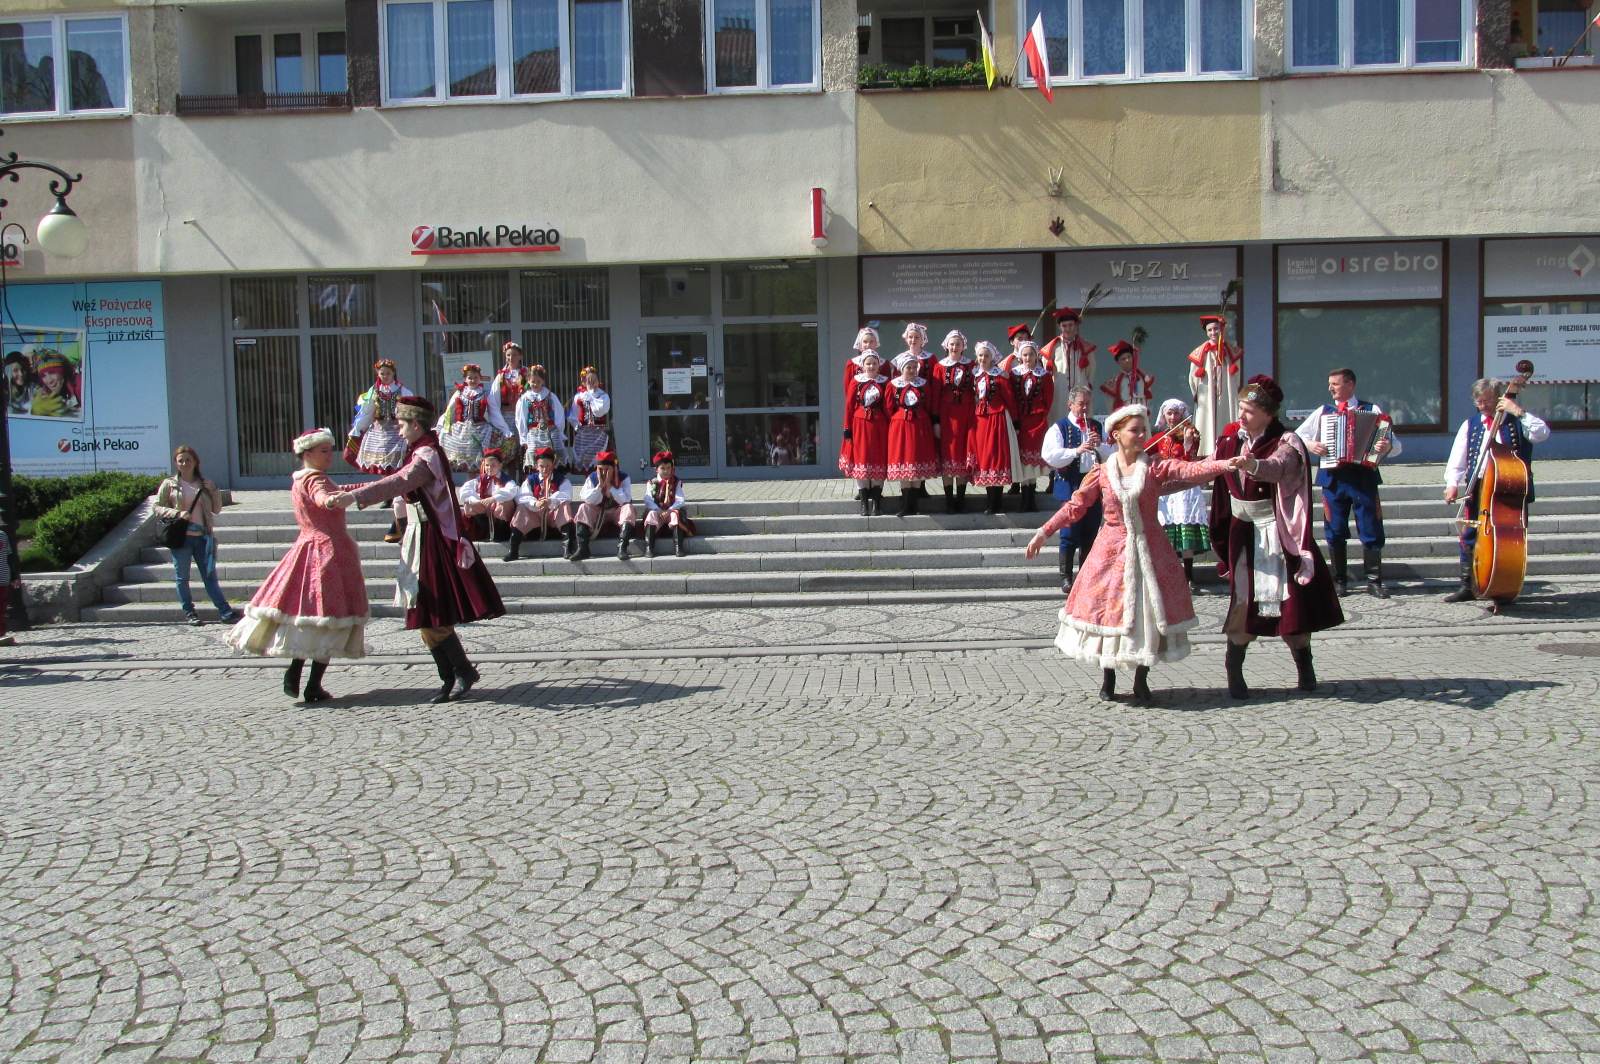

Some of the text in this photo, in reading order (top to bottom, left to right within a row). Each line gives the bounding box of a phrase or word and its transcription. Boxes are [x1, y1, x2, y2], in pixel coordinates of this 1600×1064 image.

[438, 225, 560, 248] Bank Pekao
[72, 299, 152, 312] Weź Pożyczkę
[84, 315, 153, 328] Ekspresową
[107, 331, 125, 344] już
[72, 438, 140, 452] Bank Pekao
